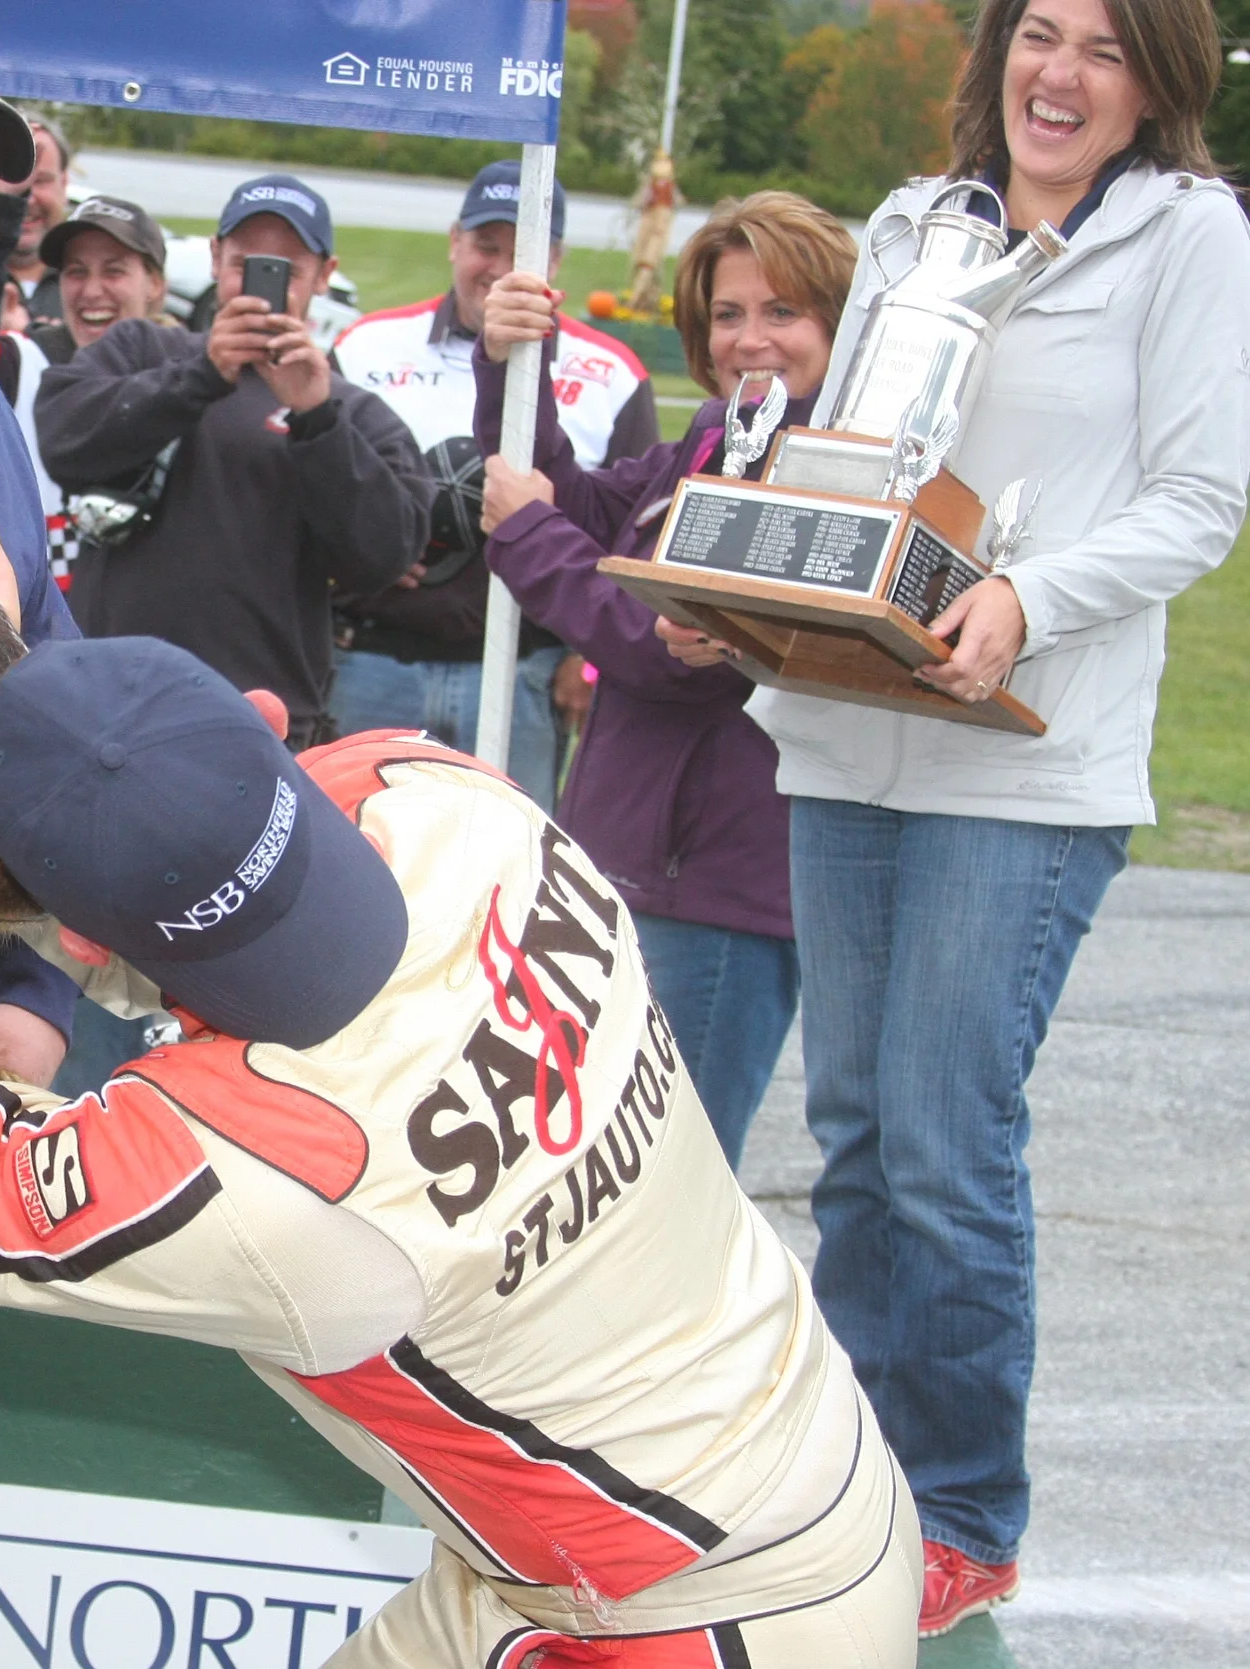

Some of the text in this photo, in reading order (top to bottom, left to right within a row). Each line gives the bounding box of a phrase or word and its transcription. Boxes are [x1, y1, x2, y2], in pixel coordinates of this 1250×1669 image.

[376, 70, 473, 92] LENDER
[377, 56, 473, 74] EQUAL HOUSING
[500, 68, 562, 98] FDIC
[237, 781, 292, 883] NORTHFIELD
[244, 792, 297, 889] SAVINGS BANK
[155, 881, 245, 942] NSB
[17, 1145, 52, 1236] SIMPSON
